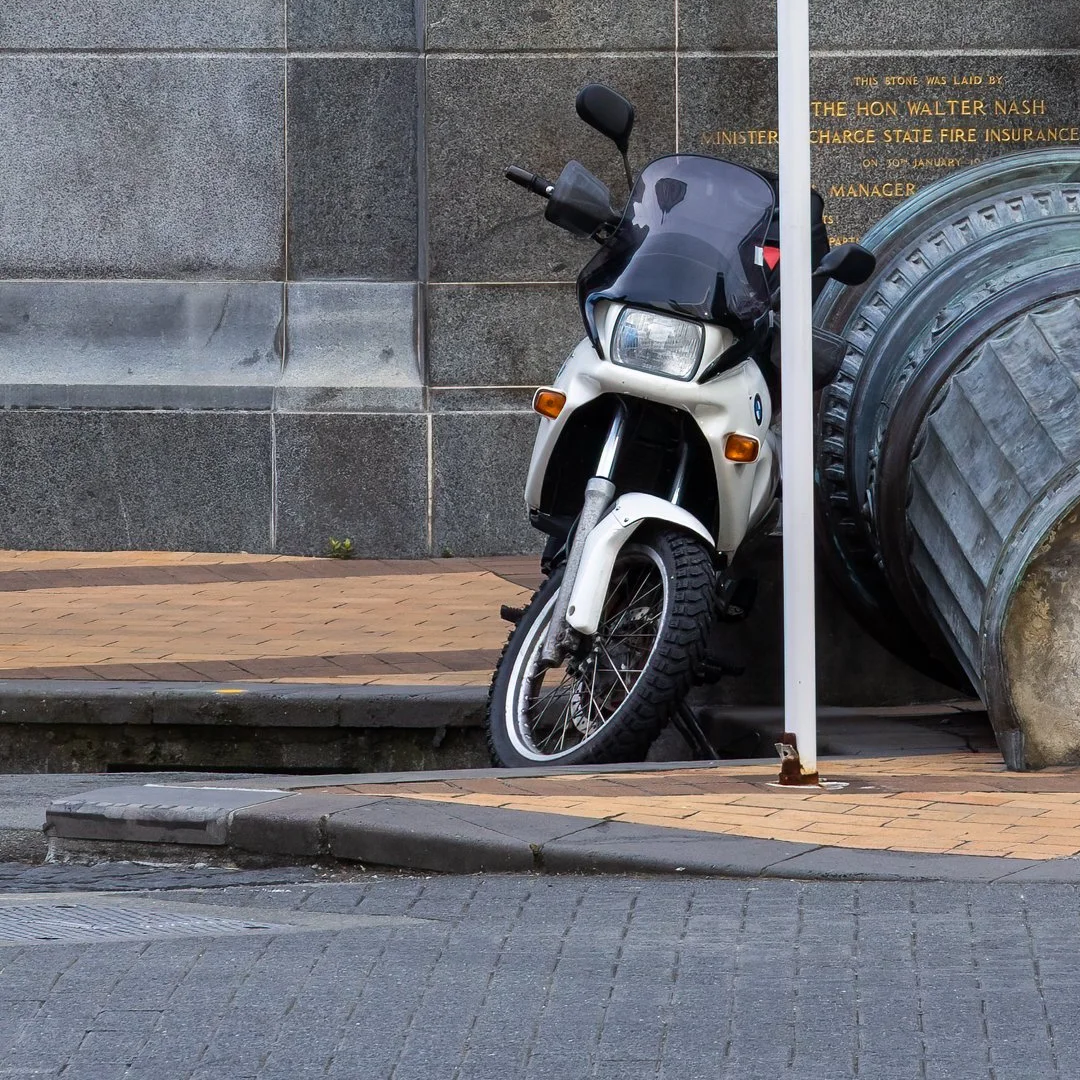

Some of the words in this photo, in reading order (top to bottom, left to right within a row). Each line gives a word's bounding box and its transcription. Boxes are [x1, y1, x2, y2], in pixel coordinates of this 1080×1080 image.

[854, 76, 879, 86] THIS
[885, 76, 919, 86] STONE
[926, 75, 948, 86] WAS
[953, 75, 983, 86] LAID
[988, 75, 1004, 85] BY
[811, 101, 847, 117] THE
[857, 101, 897, 117] HON
[907, 99, 987, 117] WALTER
[994, 99, 1046, 116] NASH
[809, 129, 876, 144] CHARGE
[883, 129, 933, 144] STATE
[940, 128, 977, 143] FIRE
[985, 127, 1080, 143] INSURANCE
[862, 158, 879, 168] ON
[913, 157, 963, 169] JANUARY
[829, 183, 917, 198] MANAGER
